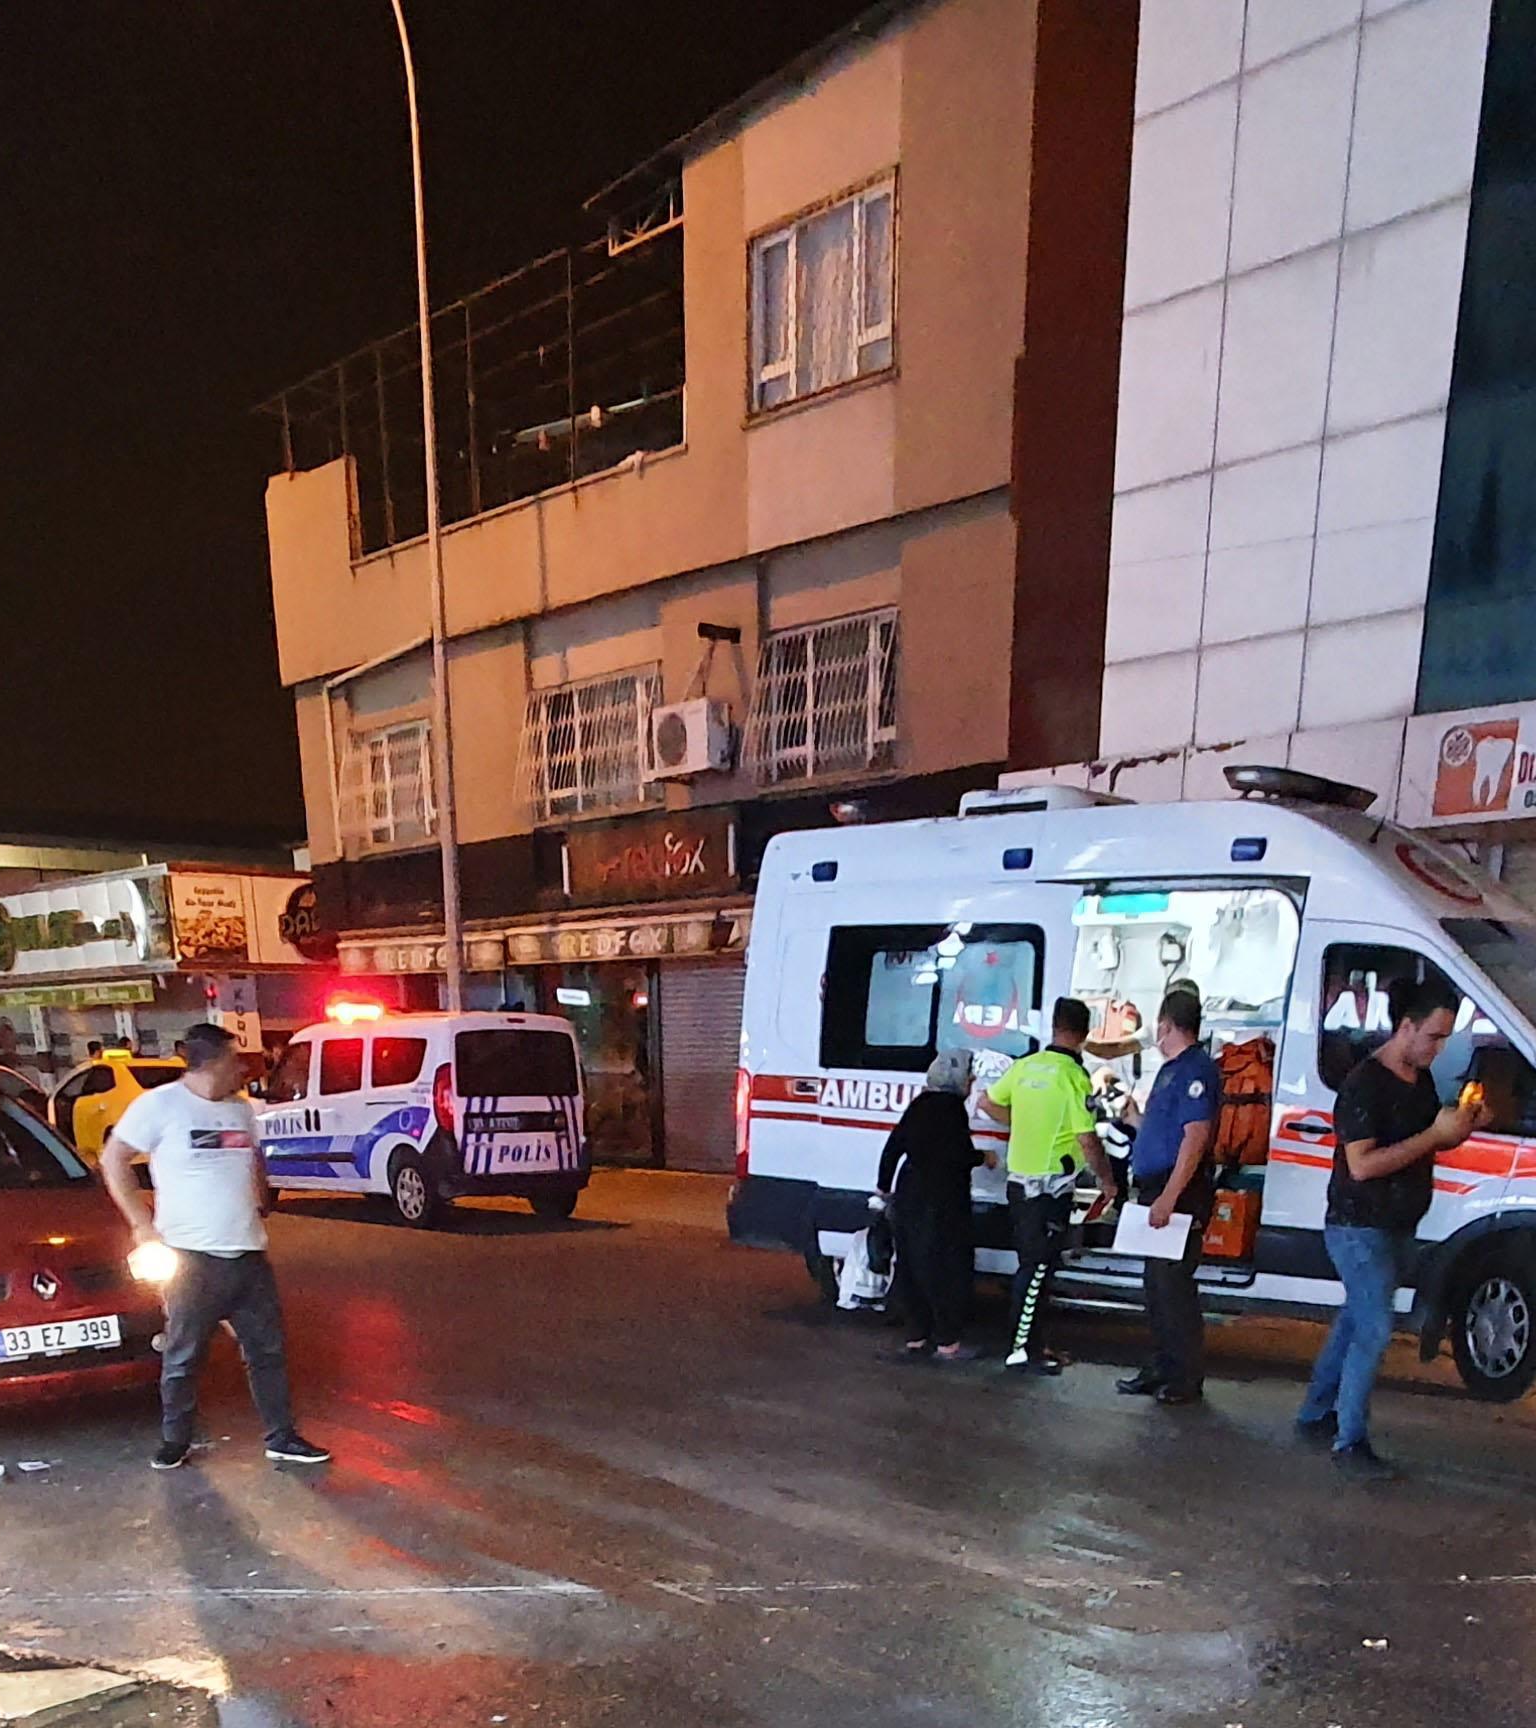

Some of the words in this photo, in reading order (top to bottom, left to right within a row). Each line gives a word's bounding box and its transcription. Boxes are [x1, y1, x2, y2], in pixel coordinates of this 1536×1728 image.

[498, 1139, 552, 1163] POLİS
[6, 1330, 31, 1352] 33
[41, 1326, 66, 1347] EZ
[78, 1320, 112, 1342] 399
